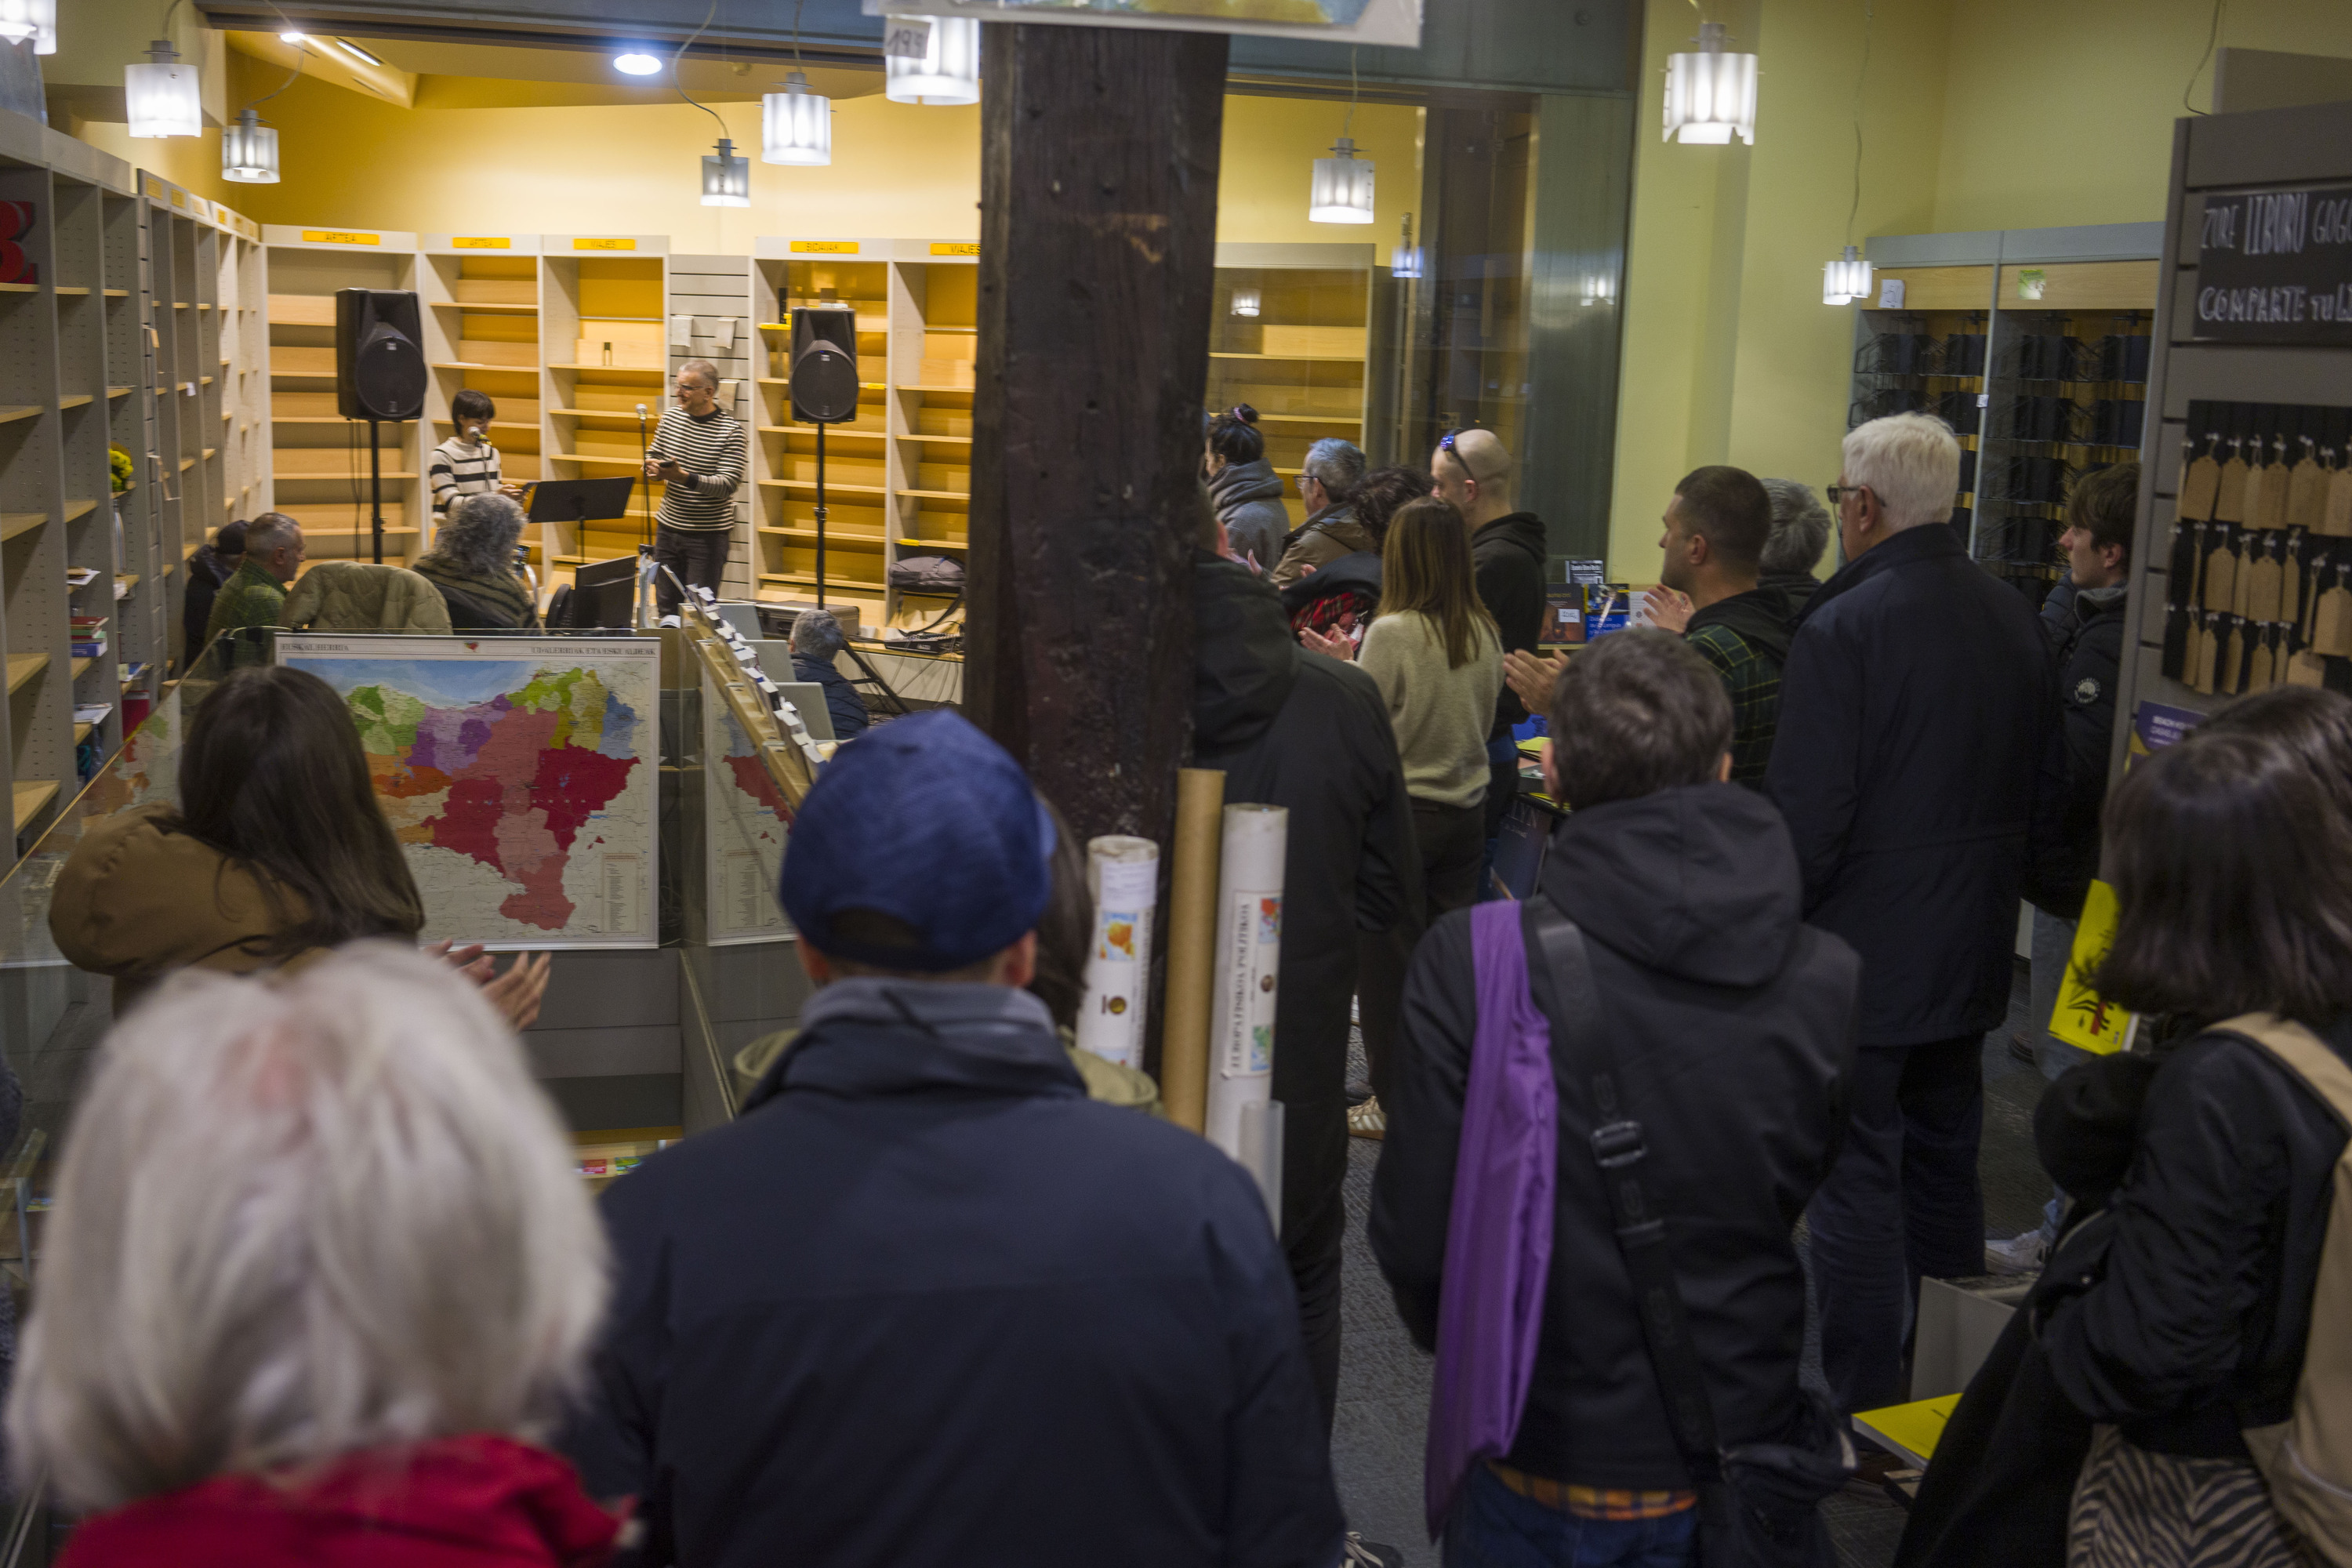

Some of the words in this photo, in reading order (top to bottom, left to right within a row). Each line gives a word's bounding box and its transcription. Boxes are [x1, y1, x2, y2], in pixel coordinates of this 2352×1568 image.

[2201, 204, 2238, 249] ZURE
[2243, 193, 2308, 255] LIBURU
[949, 244, 981, 254] VIAJES
[2198, 285, 2307, 322] COMPARTE
